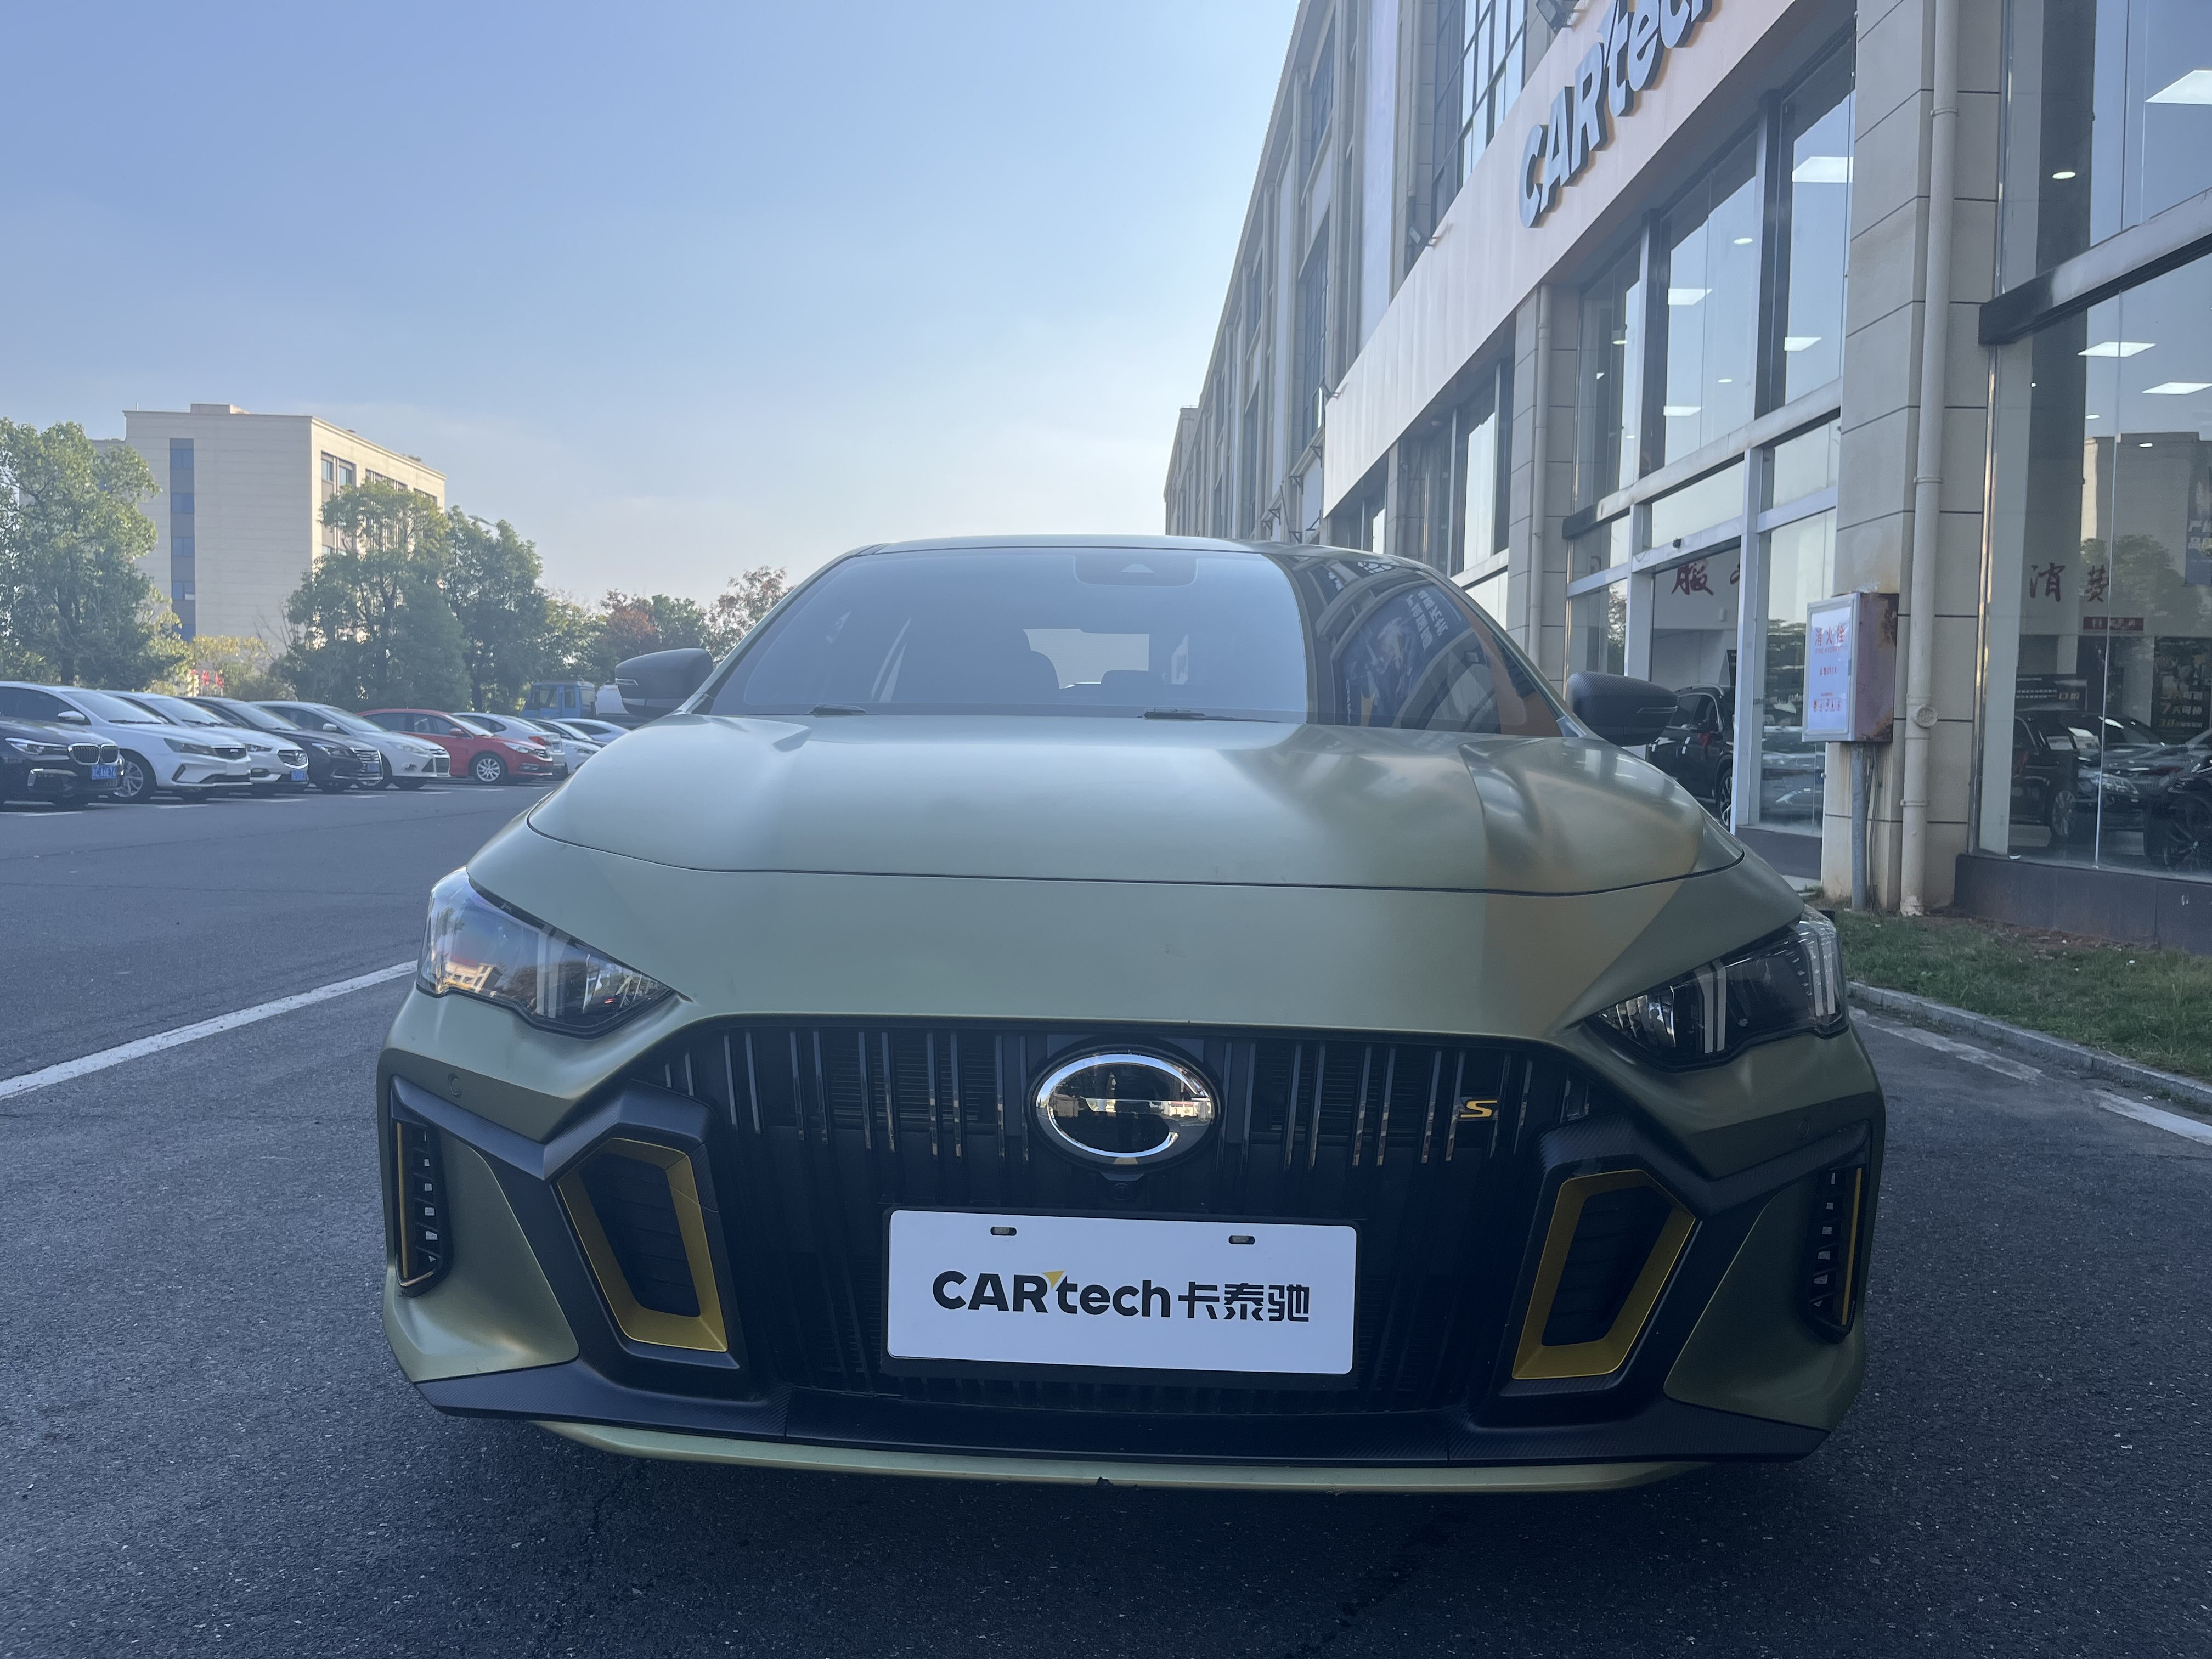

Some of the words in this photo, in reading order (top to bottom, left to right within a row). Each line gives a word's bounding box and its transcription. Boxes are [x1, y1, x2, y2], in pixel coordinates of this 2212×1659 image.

[1519, 0, 1703, 228] CARtec
[1460, 1099, 1498, 1118] S
[932, 1270, 1171, 1318] CARtech
[1178, 1281, 1310, 1322] 卡泰驰
